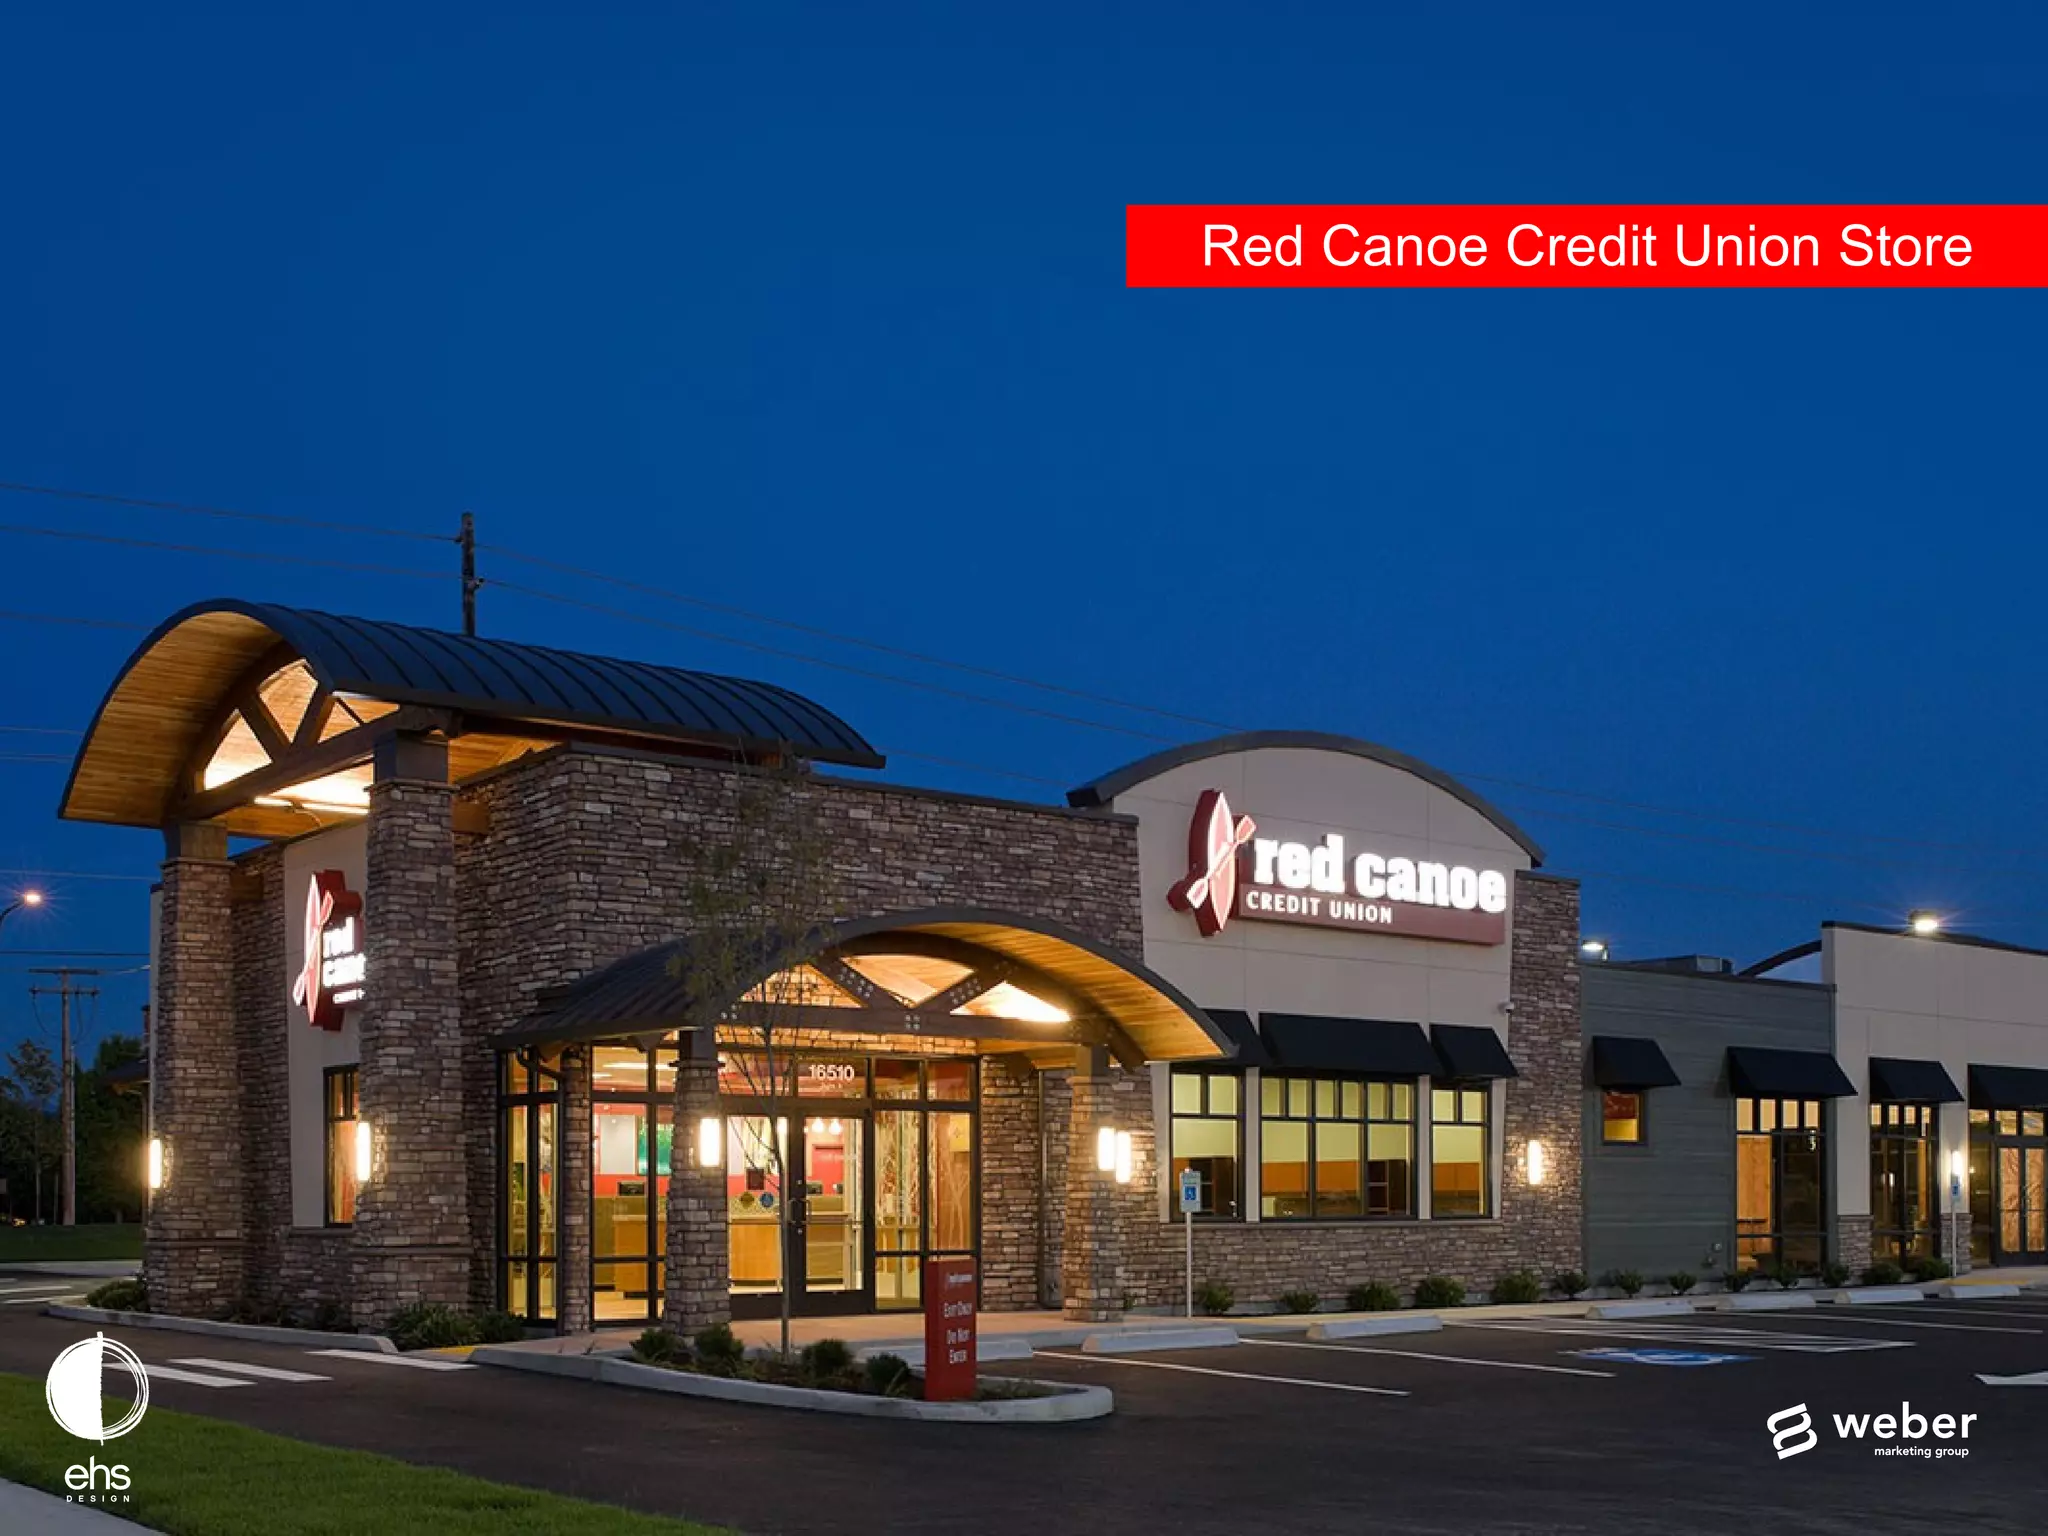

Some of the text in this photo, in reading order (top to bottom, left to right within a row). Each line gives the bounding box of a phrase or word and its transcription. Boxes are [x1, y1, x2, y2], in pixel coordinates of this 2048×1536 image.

[1253, 833, 1507, 913] red canoe
[1247, 891, 1393, 924] CREDIT UNION
[808, 1064, 855, 1082] 16510
